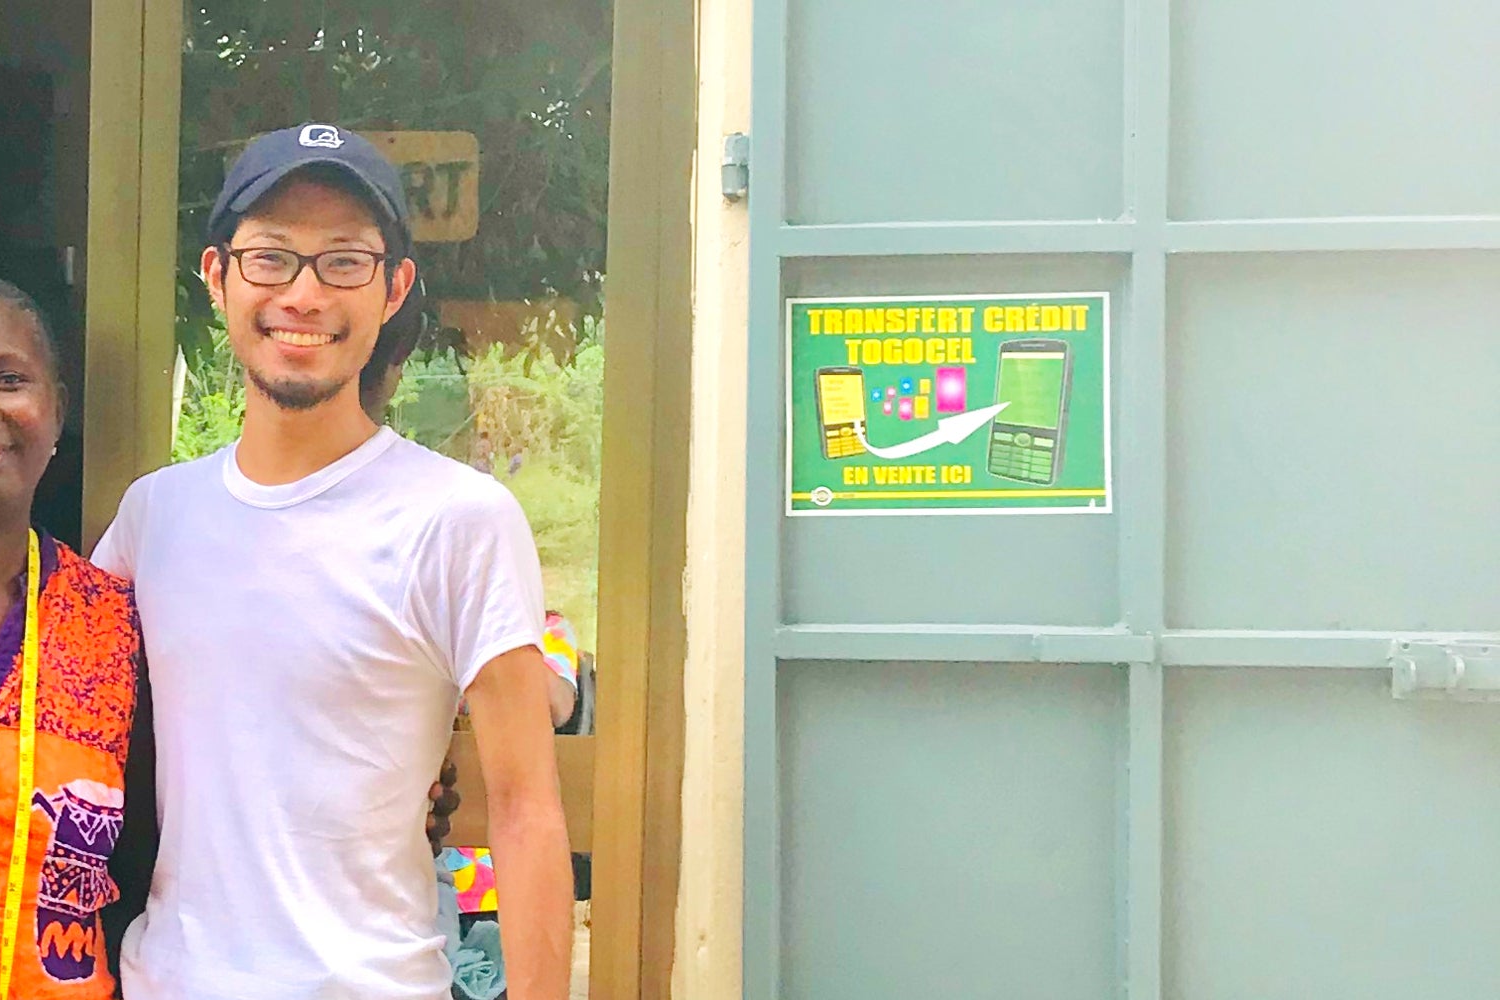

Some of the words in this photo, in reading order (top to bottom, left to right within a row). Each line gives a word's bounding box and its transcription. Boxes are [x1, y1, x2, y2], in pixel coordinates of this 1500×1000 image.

[807, 307, 975, 335] TRANSFERT
[983, 302, 1089, 332] CRÉDIT
[845, 337, 976, 365] TOGOCEL
[843, 466, 868, 485] EN
[873, 465, 936, 485] VENTE
[941, 465, 972, 484] ICI
